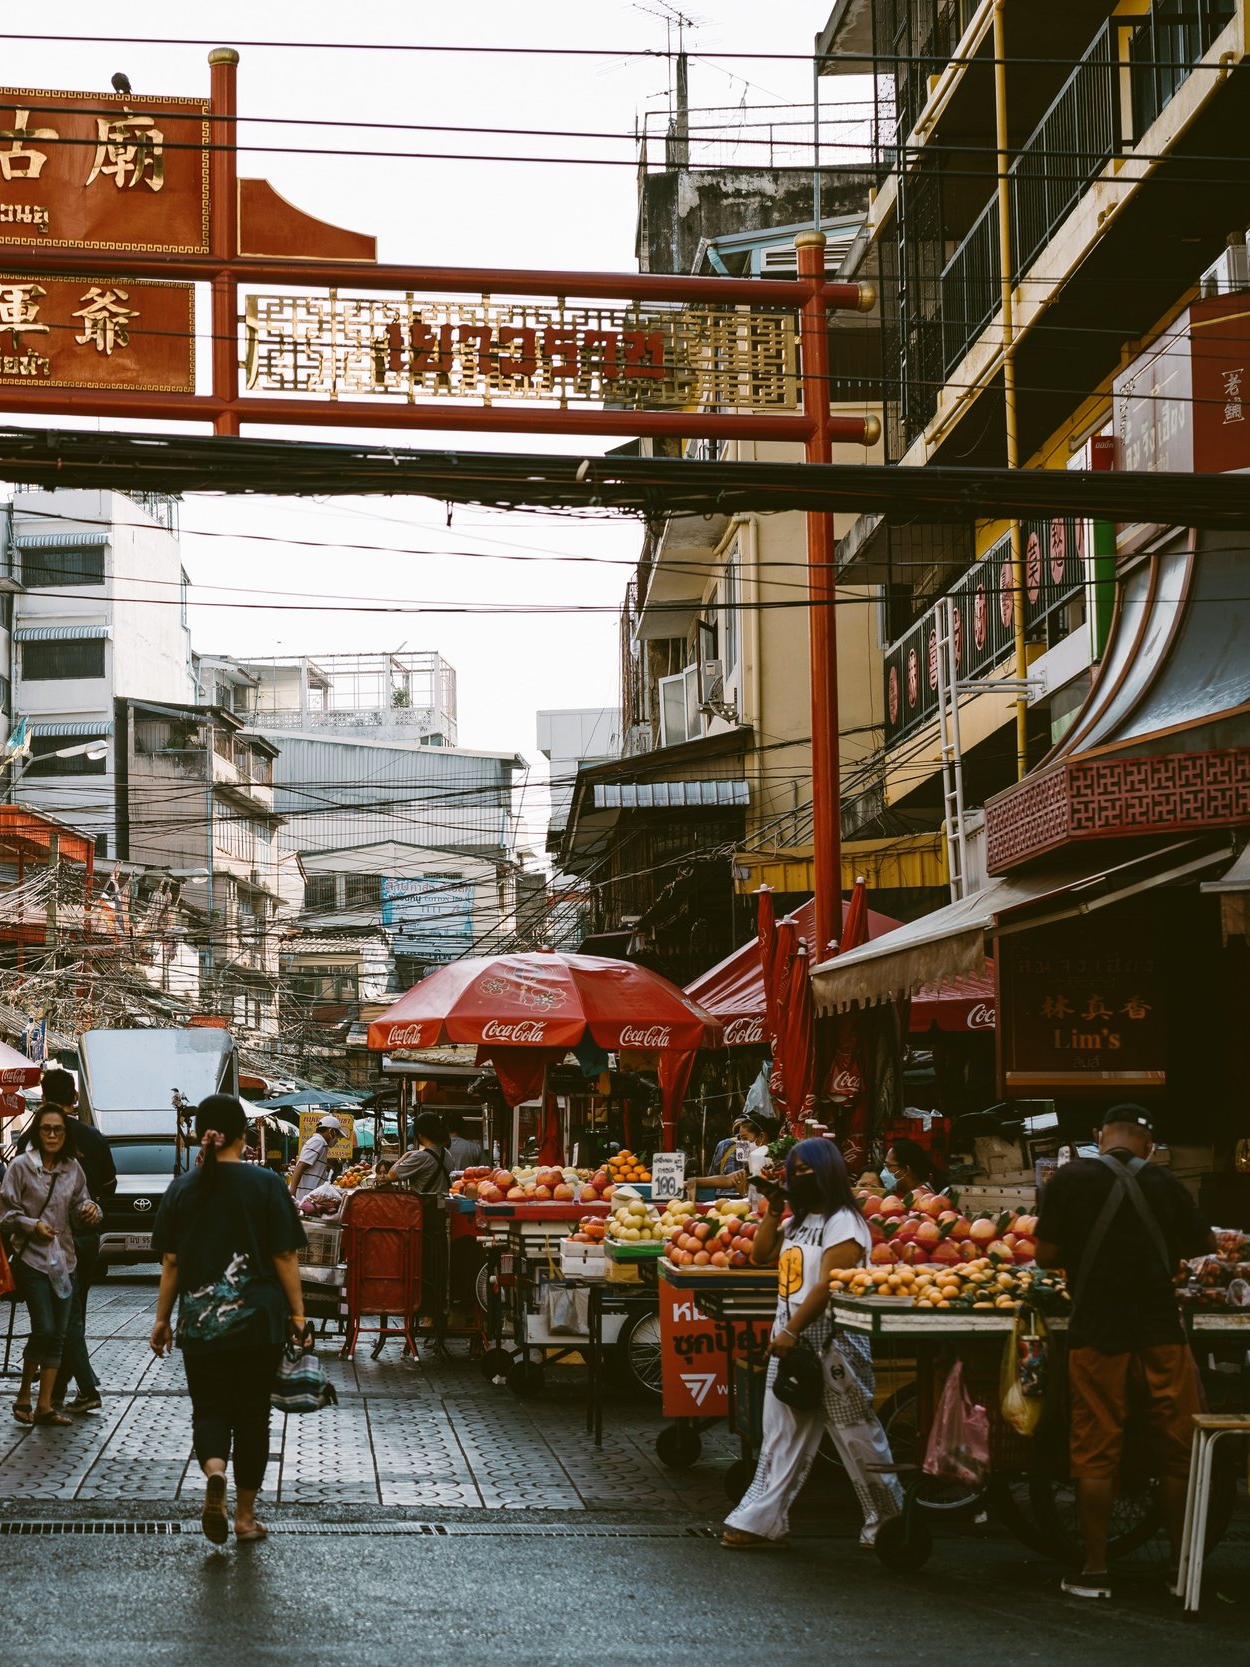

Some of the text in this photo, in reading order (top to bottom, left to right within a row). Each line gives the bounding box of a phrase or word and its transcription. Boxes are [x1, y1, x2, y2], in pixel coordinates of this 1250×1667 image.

[386, 322, 666, 380] เยาวราช
[1041, 993, 1153, 1021] 林真香
[387, 1023, 424, 1046] Coca-Cola
[481, 1019, 549, 1043] Coca-Cola
[619, 1025, 671, 1048] Coca-Cola
[1053, 1029, 1121, 1049] Lim's
